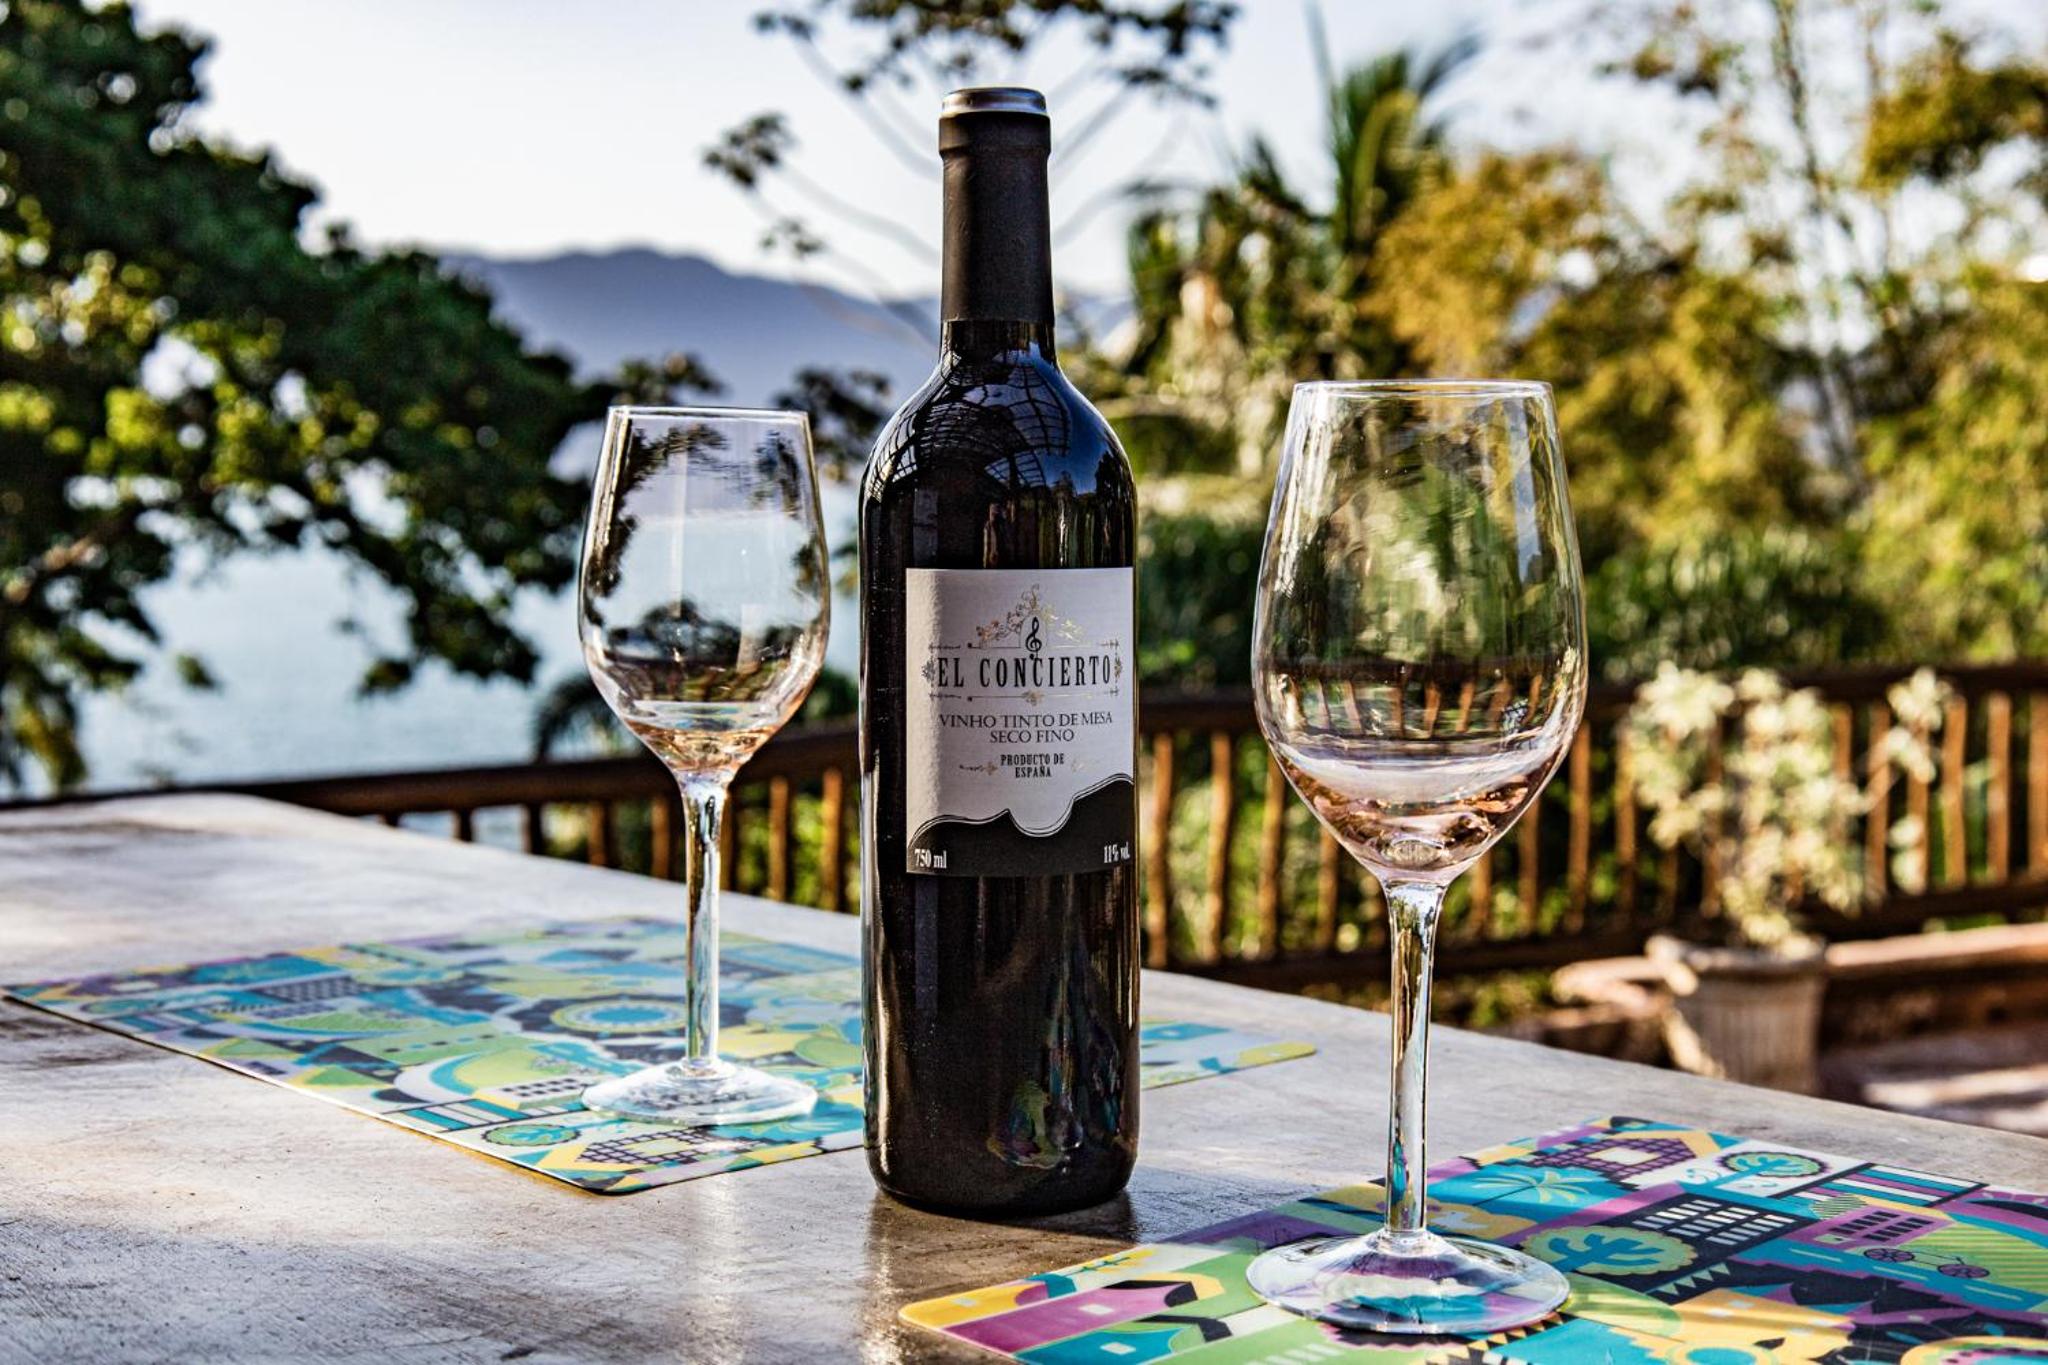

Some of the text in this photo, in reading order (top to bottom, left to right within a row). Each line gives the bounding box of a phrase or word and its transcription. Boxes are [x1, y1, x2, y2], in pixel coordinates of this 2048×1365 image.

[937, 655, 1110, 687] EL CONCIERTO
[939, 710, 1113, 728] VINHO TINTO DE MESA
[990, 728, 1075, 744] SECO FINO
[1000, 752, 1065, 767] PRODUCTO DE
[1015, 764, 1052, 779] ESPAÑA
[914, 848, 947, 868] 750 ml
[1103, 844, 1119, 863] 11%
